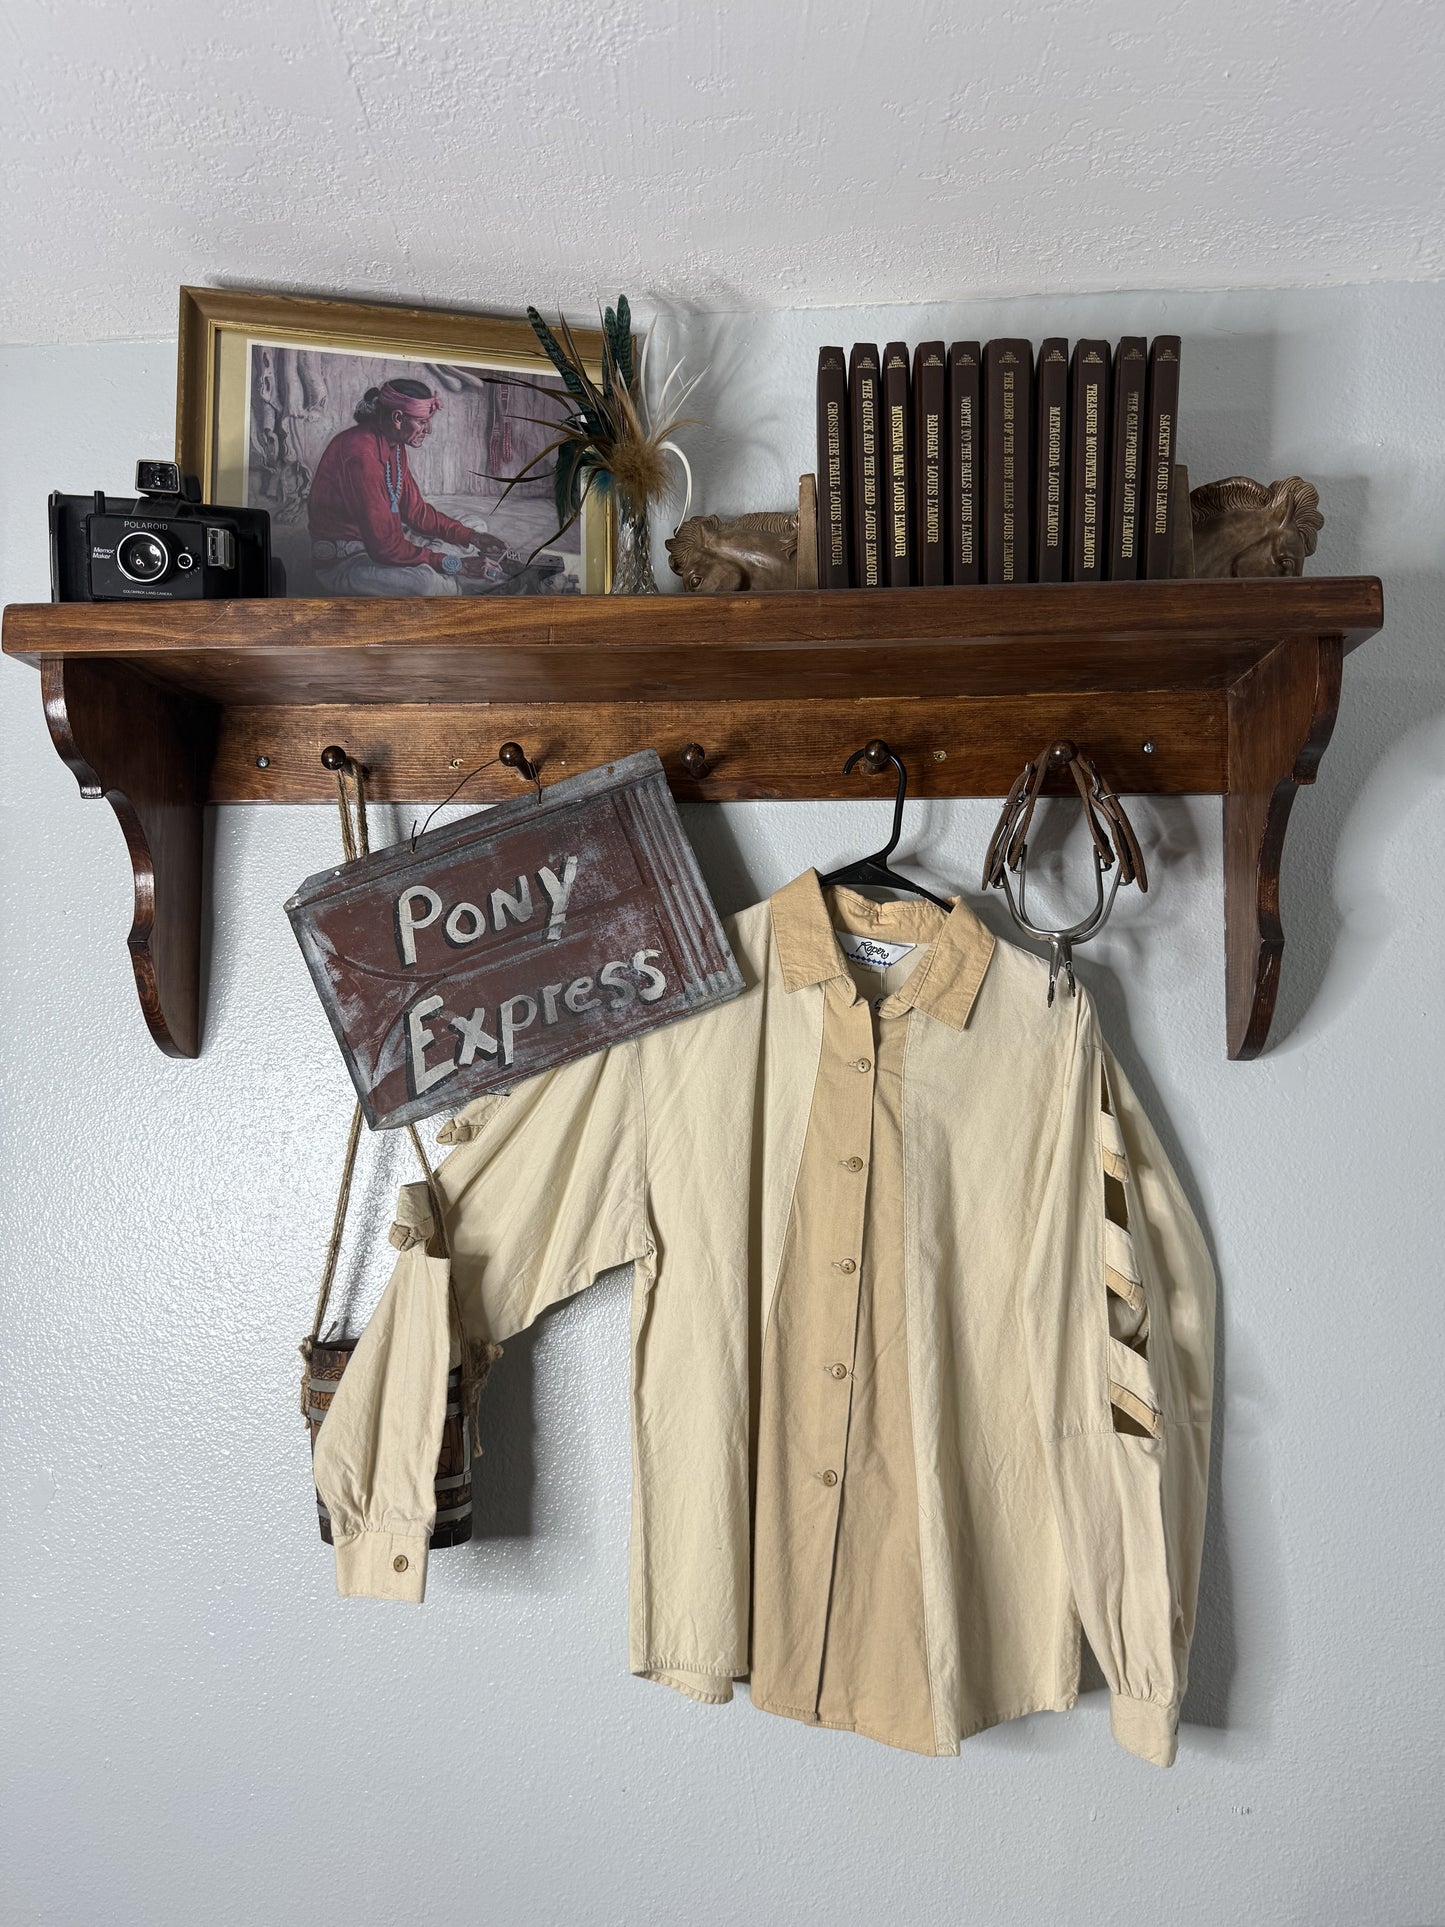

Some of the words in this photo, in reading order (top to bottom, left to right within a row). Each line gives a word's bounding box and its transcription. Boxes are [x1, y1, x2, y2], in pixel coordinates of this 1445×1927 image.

[862, 379, 872, 399] THE
[1004, 371, 1014, 389] THE
[862, 401, 873, 431] QUICK
[961, 396, 971, 427] NORTH
[1004, 392, 1014, 420] RIDER
[1086, 384, 1097, 434] TREASURE
[1128, 392, 1139, 412] THE
[827, 401, 839, 456] CROSSFIRE
[892, 406, 904, 454] MUSTANG
[927, 414, 938, 459] RADIGAN
[961, 430, 971, 441] TO
[1004, 422, 1014, 434] OF
[1049, 407, 1060, 467] MATAGORDA
[1159, 414, 1170, 458] SACKETT
[864, 434, 874, 454] AND
[961, 444, 972, 461] THE
[1004, 436, 1014, 454] THE
[1125, 414, 1138, 479] CALIFORNIOS
[829, 457, 840, 488] TRAIL
[864, 457, 875, 476] THE
[893, 456, 904, 476] MAN
[961, 462, 972, 489] RAILS
[1004, 456, 1014, 480] RUBY
[1085, 436, 1097, 489] MOUNTAIN
[1157, 461, 1169, 490] LOUIS
[865, 478, 875, 505] DEAD
[927, 465, 938, 496] LOUIS
[1004, 482, 1014, 509] HILLS
[1048, 472, 1060, 502] LOUIS
[830, 491, 841, 520] LOUIS
[894, 481, 905, 511] LOUIS
[962, 494, 972, 521] LOUIS
[1085, 494, 1096, 524] LOUIS
[1124, 483, 1135, 513] LOUIS
[123, 520, 168, 530] POLAROID
[865, 510, 876, 540] LOUIS
[927, 499, 938, 543] L'AMOUR
[1004, 513, 1014, 540] LOUIS
[1047, 504, 1059, 547] L'AMOUR
[1155, 493, 1167, 534] L'AMOUR
[831, 523, 843, 566] L'AMOUR
[894, 514, 906, 558] L'AMOUR
[962, 524, 972, 564] L'AMOUR
[1083, 526, 1095, 569] L'AMOUR
[1122, 516, 1134, 558] L'AMOUR
[92, 552, 111, 560] Maker
[866, 543, 877, 586] L'AMOUR
[1004, 543, 1014, 581] L'AMOUR
[856, 941, 889, 960] Roper
[406, 949, 667, 1099] Express
